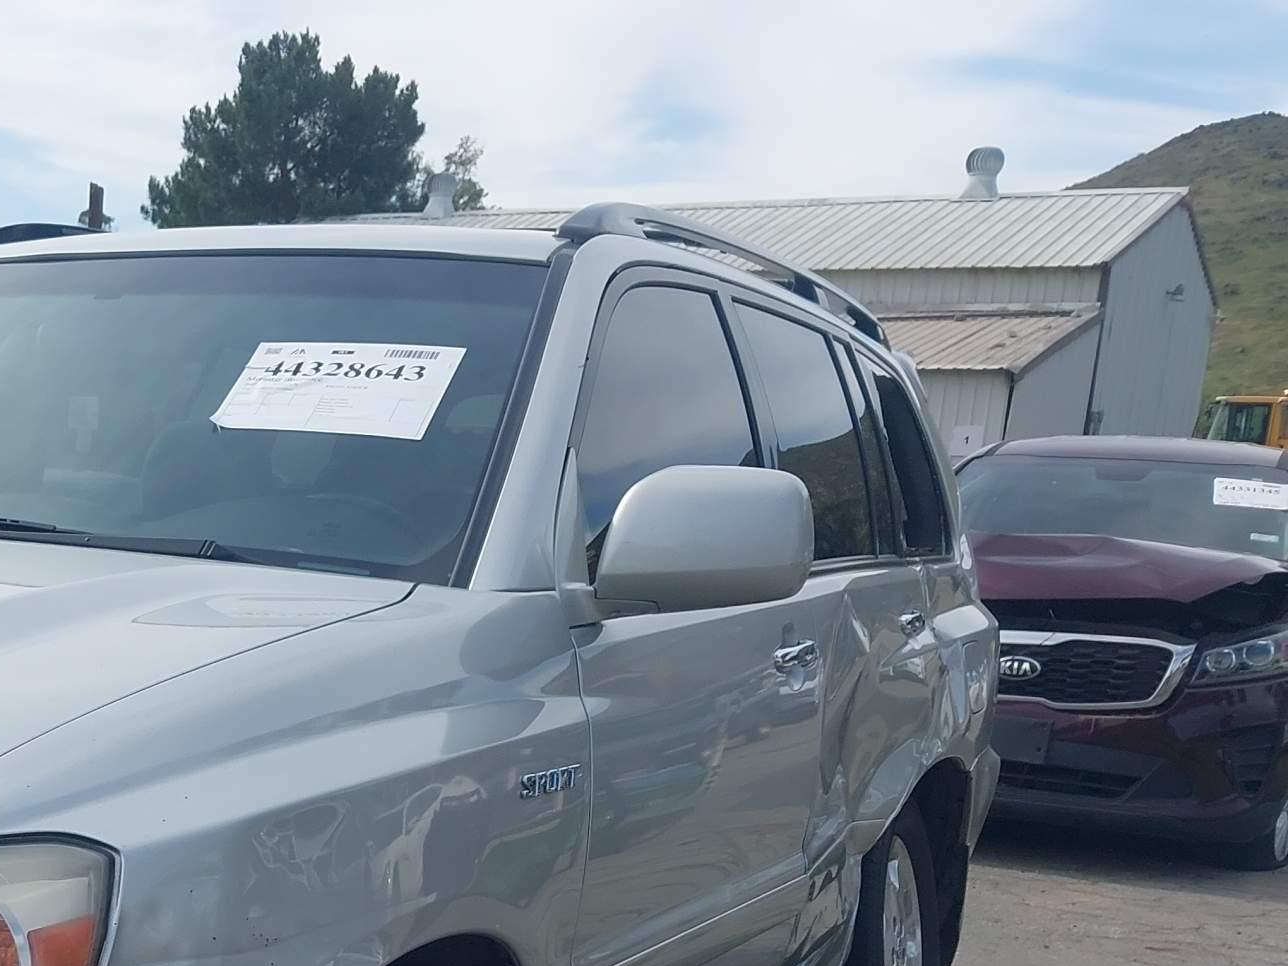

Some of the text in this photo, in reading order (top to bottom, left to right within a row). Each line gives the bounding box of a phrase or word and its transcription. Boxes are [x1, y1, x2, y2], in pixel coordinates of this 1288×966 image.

[264, 360, 427, 382] 44328643
[999, 660, 1032, 676] KIA
[520, 763, 581, 799] SPORT
